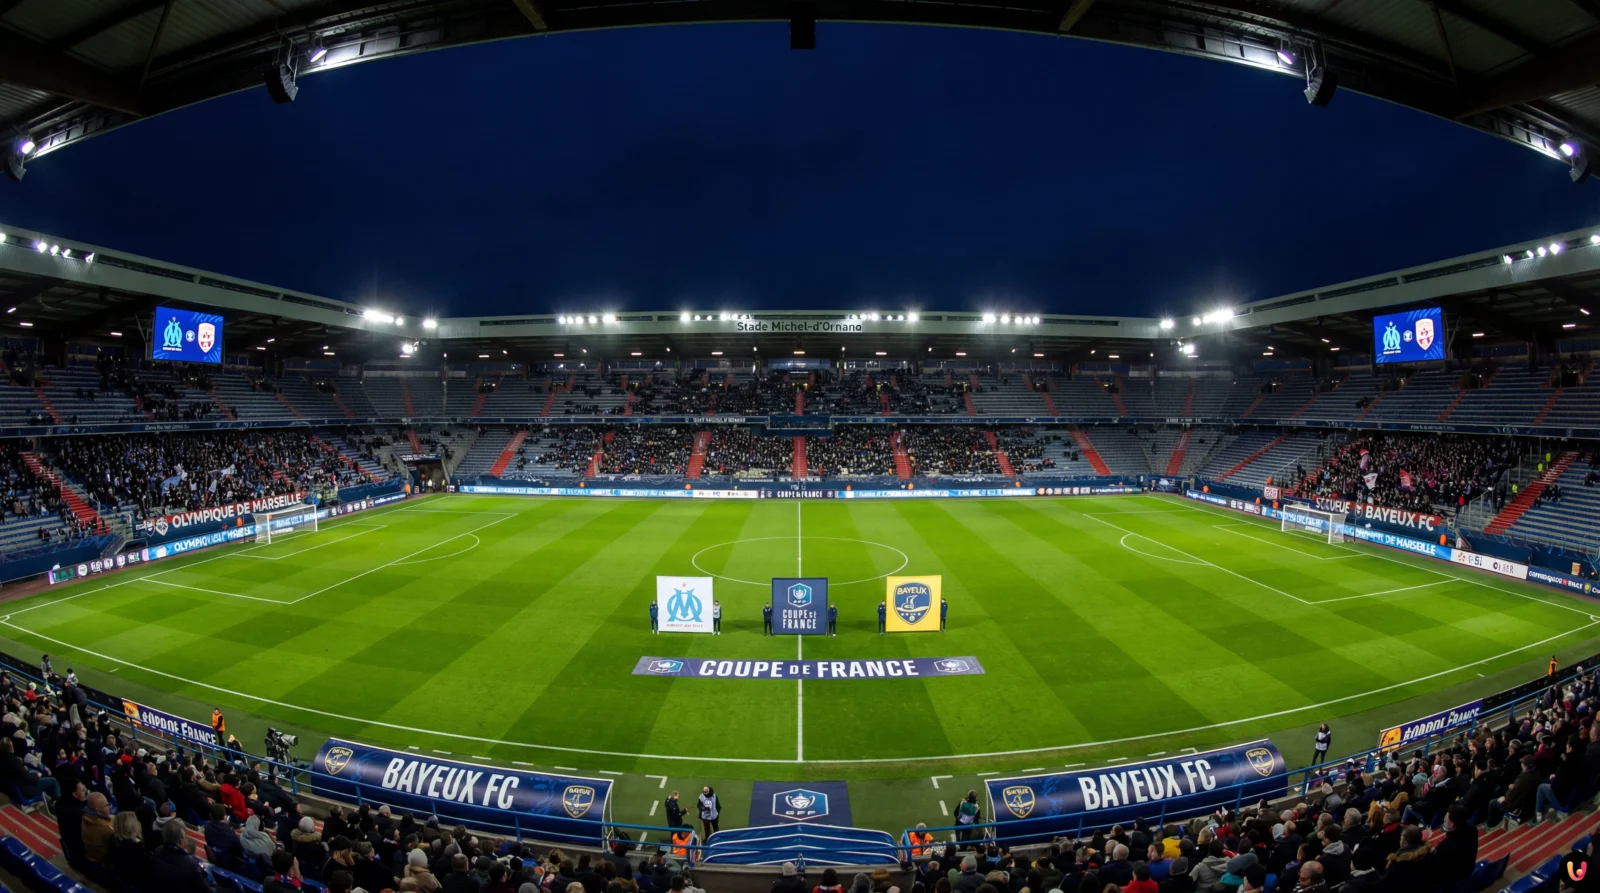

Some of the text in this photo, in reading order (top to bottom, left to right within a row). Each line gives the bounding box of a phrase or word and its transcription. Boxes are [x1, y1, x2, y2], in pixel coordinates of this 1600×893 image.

[737, 321, 862, 332] Stade Michel-d'Ornano
[172, 493, 301, 529] OLYMPIQUE DE MARSEILLE
[1365, 503, 1435, 532] BAYEUX FC
[1396, 536, 1436, 556] MARSEILLE
[897, 586, 927, 595] BAYEUX
[782, 609, 808, 619] COUPE
[782, 619, 817, 629] FRANCE
[699, 660, 919, 678] COUPE DE FRANCE
[382, 757, 519, 810] BAYEUX FC
[1077, 759, 1217, 811] BAYEUX FC
